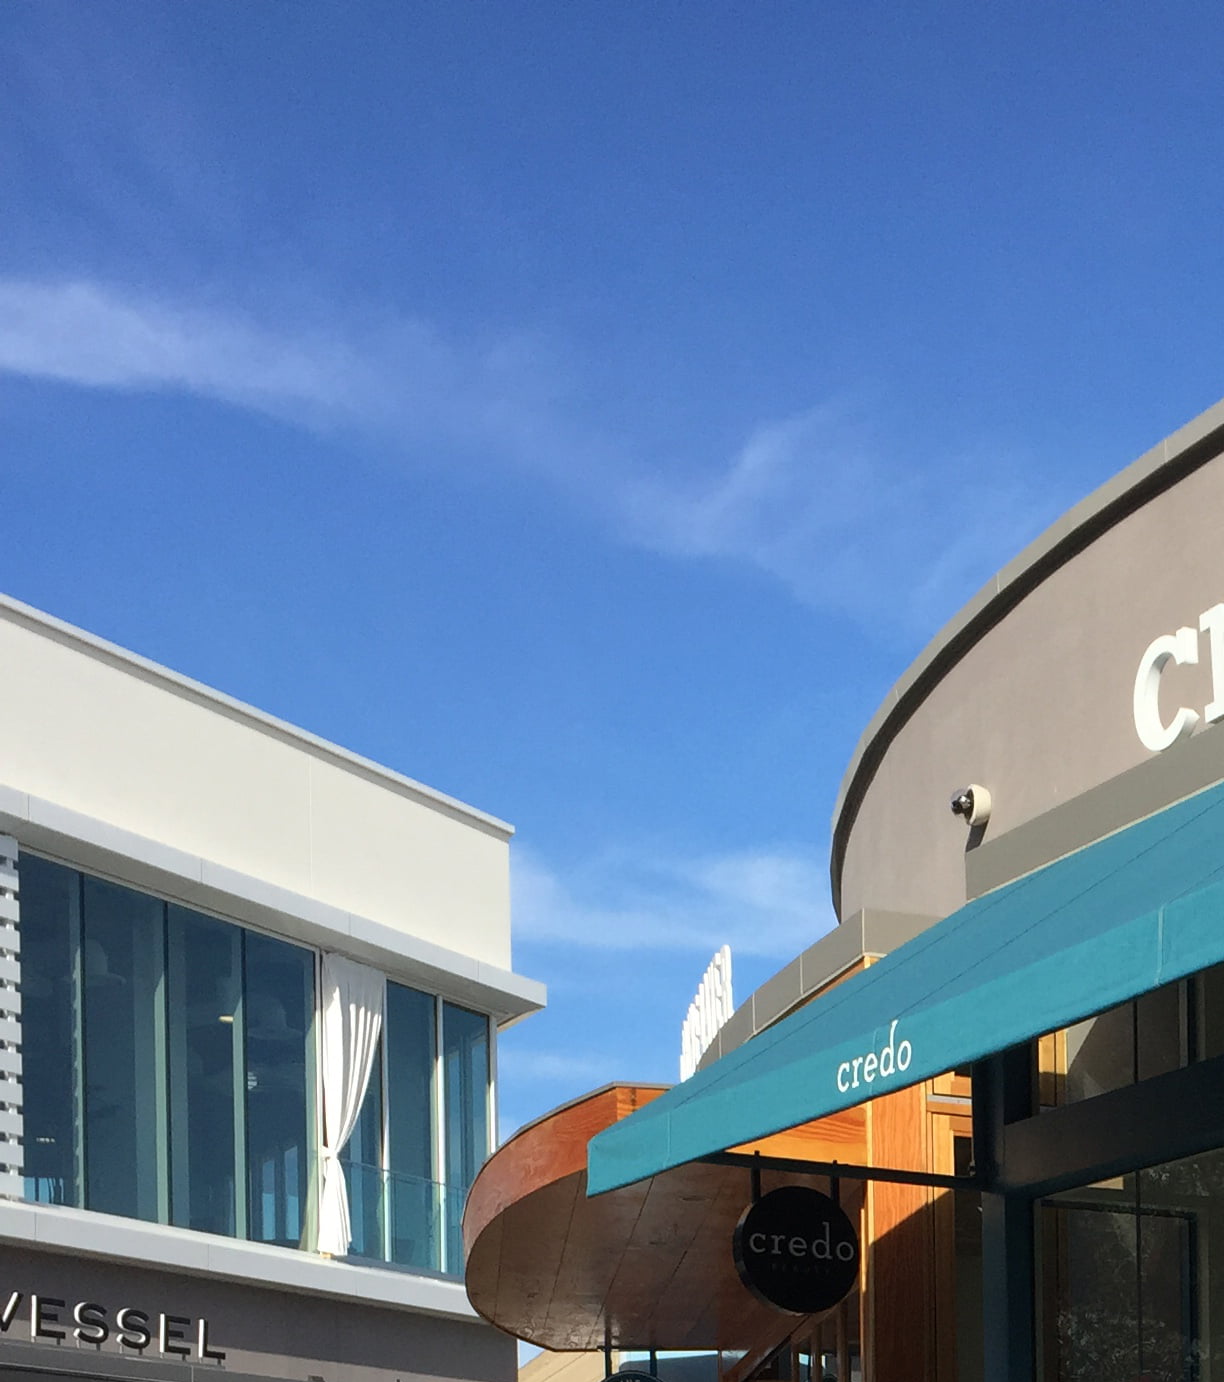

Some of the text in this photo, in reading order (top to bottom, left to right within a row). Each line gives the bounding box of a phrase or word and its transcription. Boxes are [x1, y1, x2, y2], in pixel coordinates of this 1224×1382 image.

[837, 1019, 912, 1093] credo
[749, 1221, 855, 1261] credo
[0, 1291, 226, 1360] VESSEL
